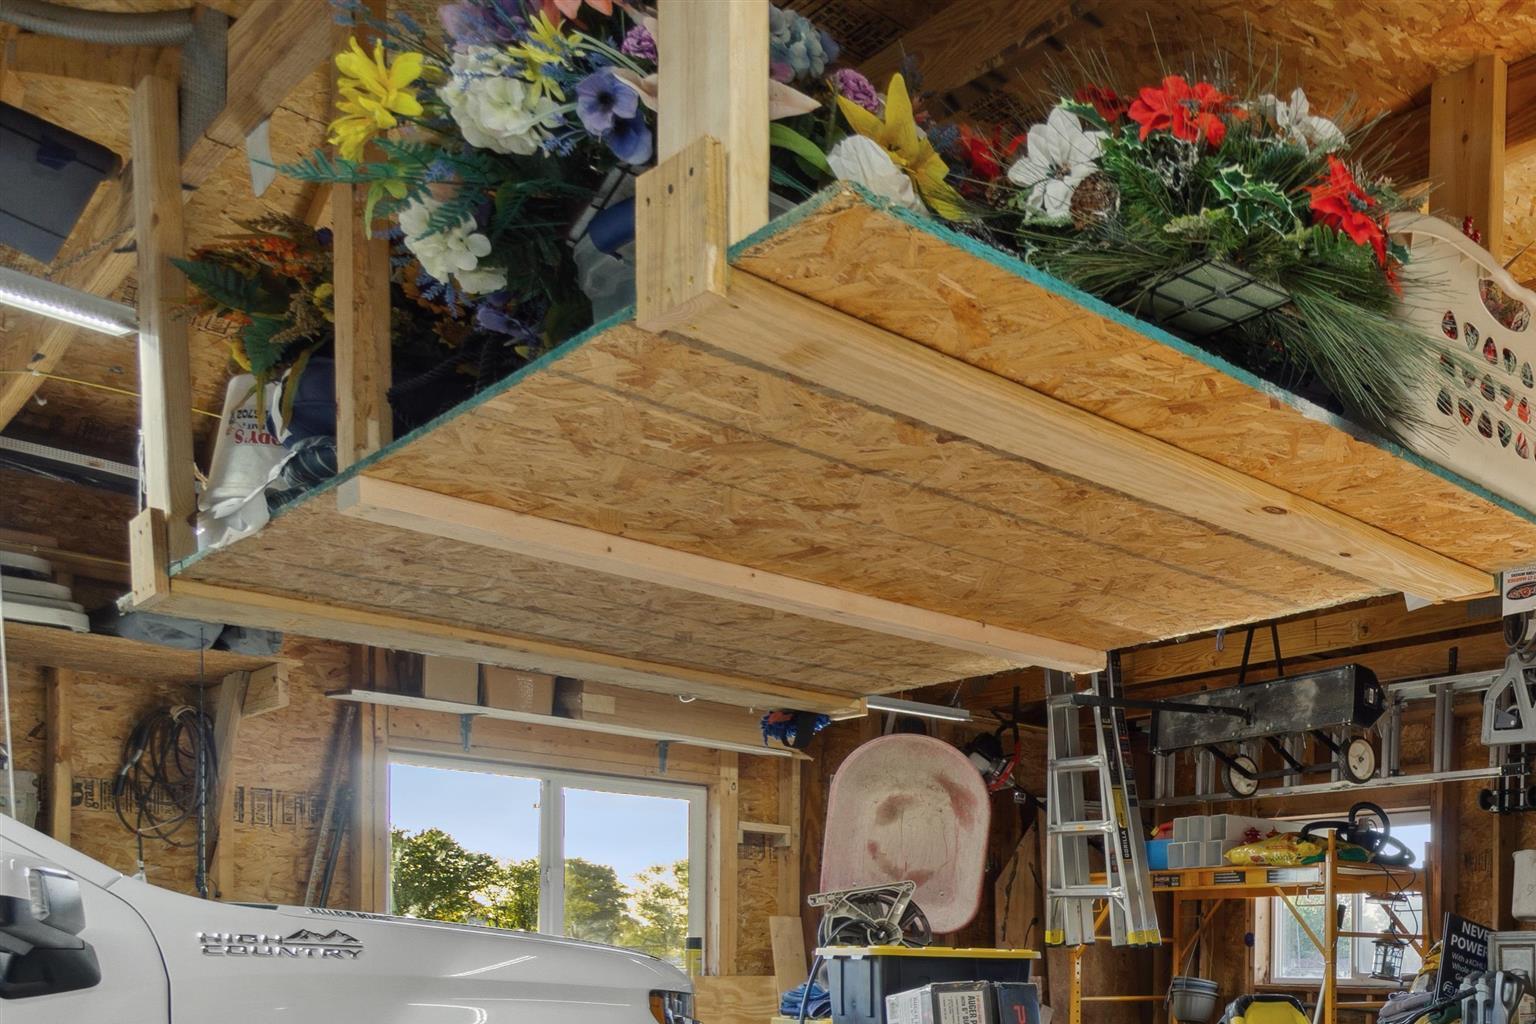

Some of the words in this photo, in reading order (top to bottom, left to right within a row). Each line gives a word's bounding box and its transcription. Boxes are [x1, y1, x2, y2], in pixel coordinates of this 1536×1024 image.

[1121, 830, 1129, 858] GORILLA
[197, 932, 284, 945] HIGH
[201, 945, 363, 960] COUNTRY
[967, 995, 977, 1019] AUGER
